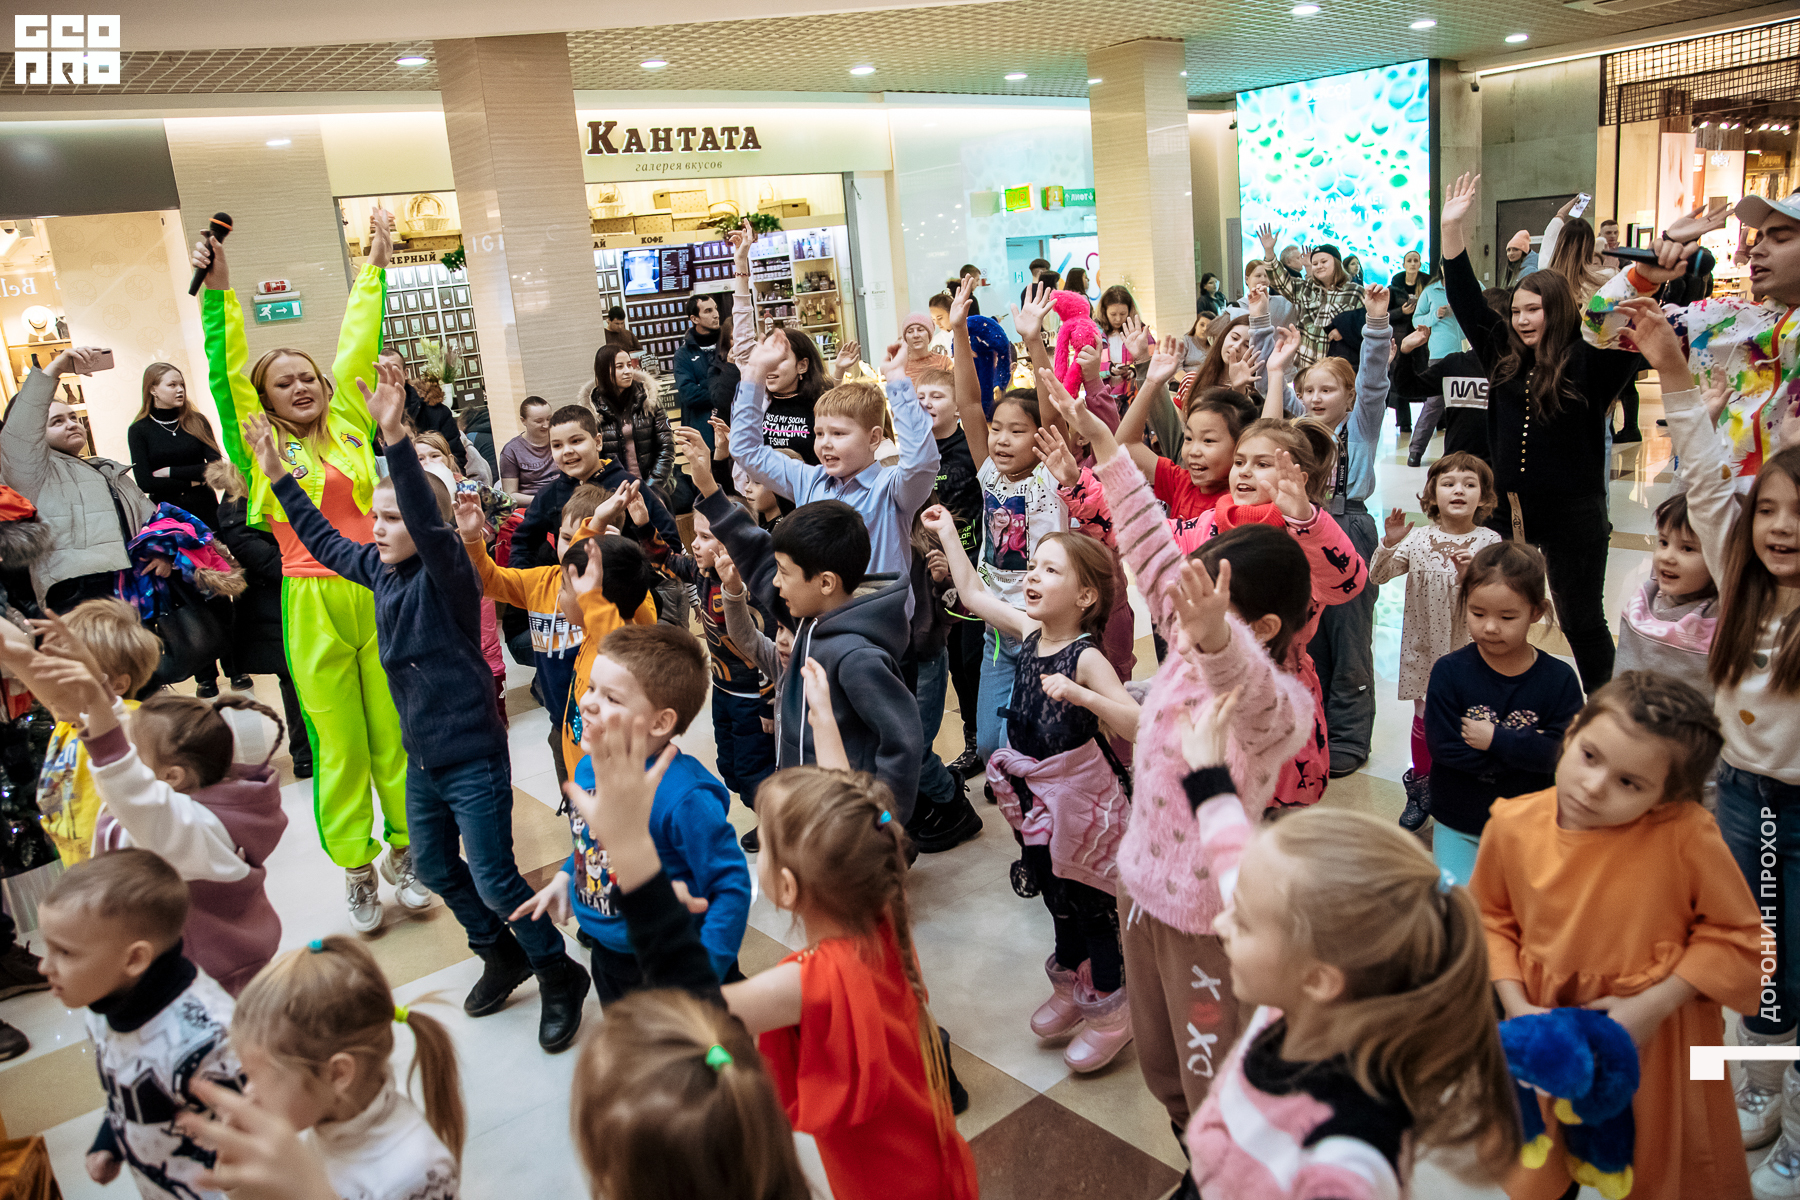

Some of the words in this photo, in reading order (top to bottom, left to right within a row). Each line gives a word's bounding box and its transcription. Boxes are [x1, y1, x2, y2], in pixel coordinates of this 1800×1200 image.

[587, 121, 762, 154] КАНТАТА
[635, 163, 682, 173] галерея
[685, 161, 723, 172] вкусов
[593, 238, 606, 248] АЙ
[641, 236, 663, 244] КОФЕ
[390, 252, 436, 265] ЧЕРНЫЙ
[1451, 381, 1489, 399] NAS
[788, 416, 806, 424] SOCIAL
[762, 421, 809, 438] STANCING
[769, 437, 790, 446] T-SHIRT
